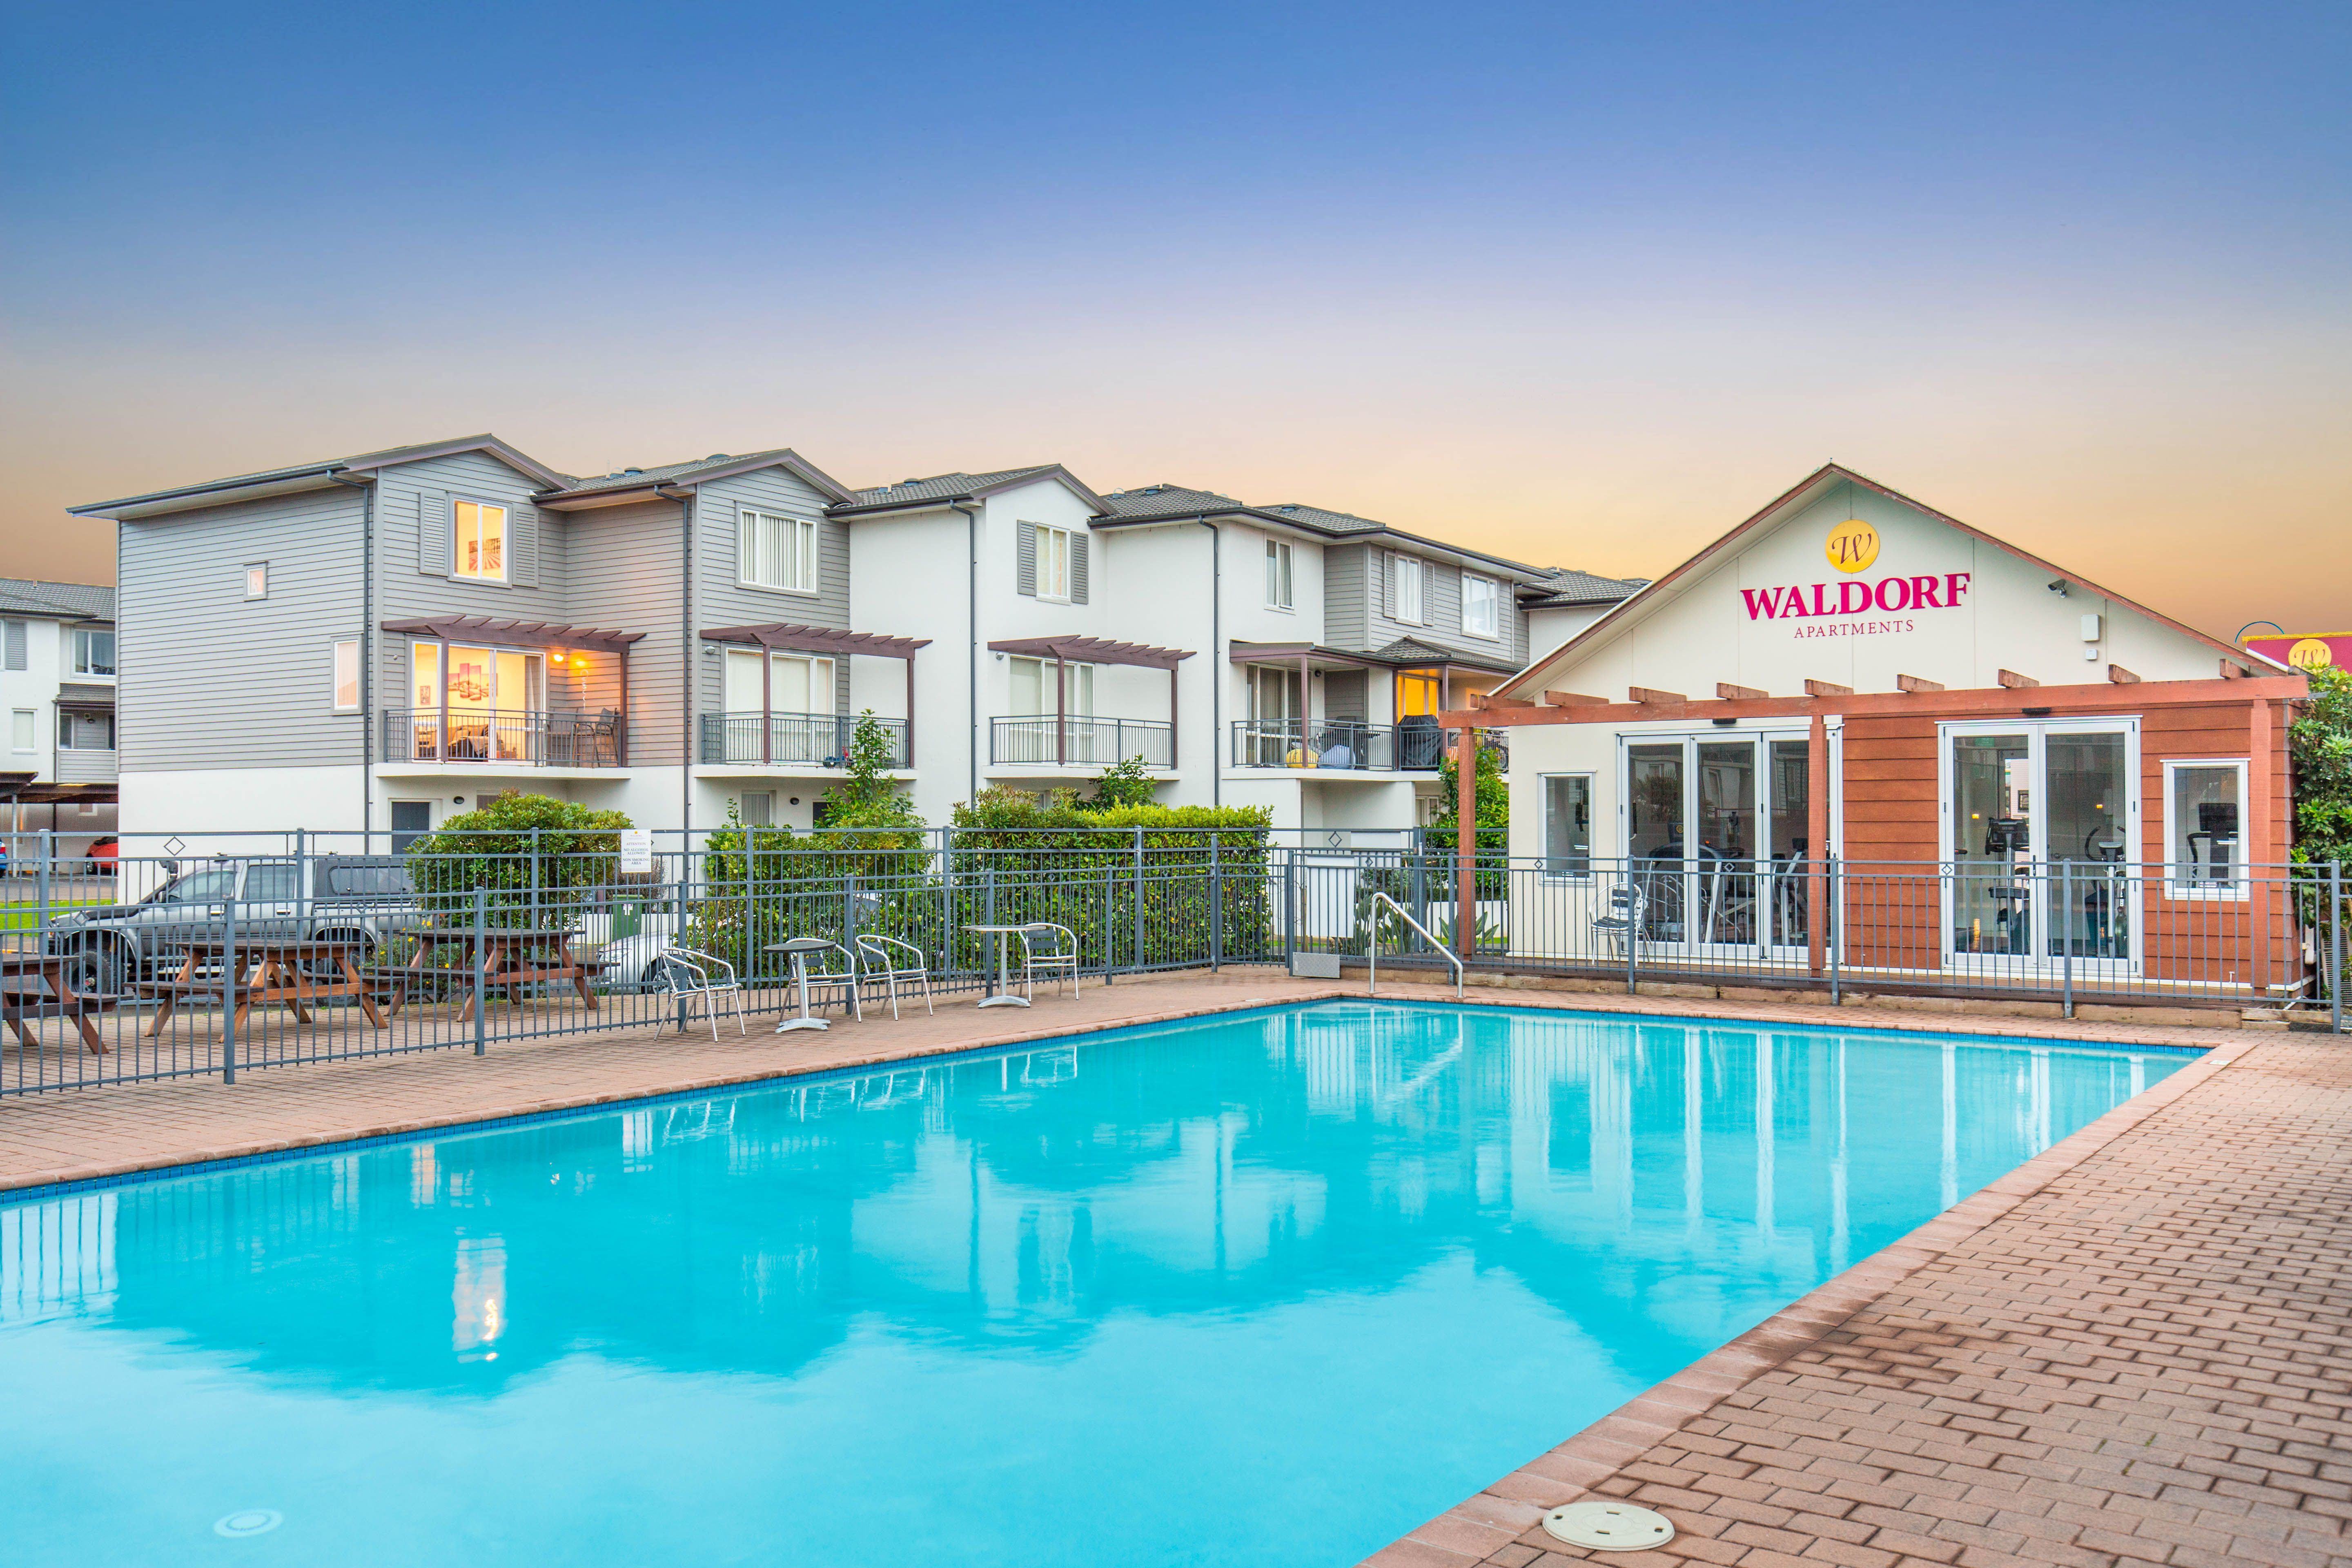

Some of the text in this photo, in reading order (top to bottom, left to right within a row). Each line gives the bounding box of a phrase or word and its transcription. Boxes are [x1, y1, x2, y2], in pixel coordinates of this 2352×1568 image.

[1832, 533, 1871, 564] W
[1740, 573, 1970, 620] WALDORF
[1794, 619, 1914, 638] APARTMENTS
